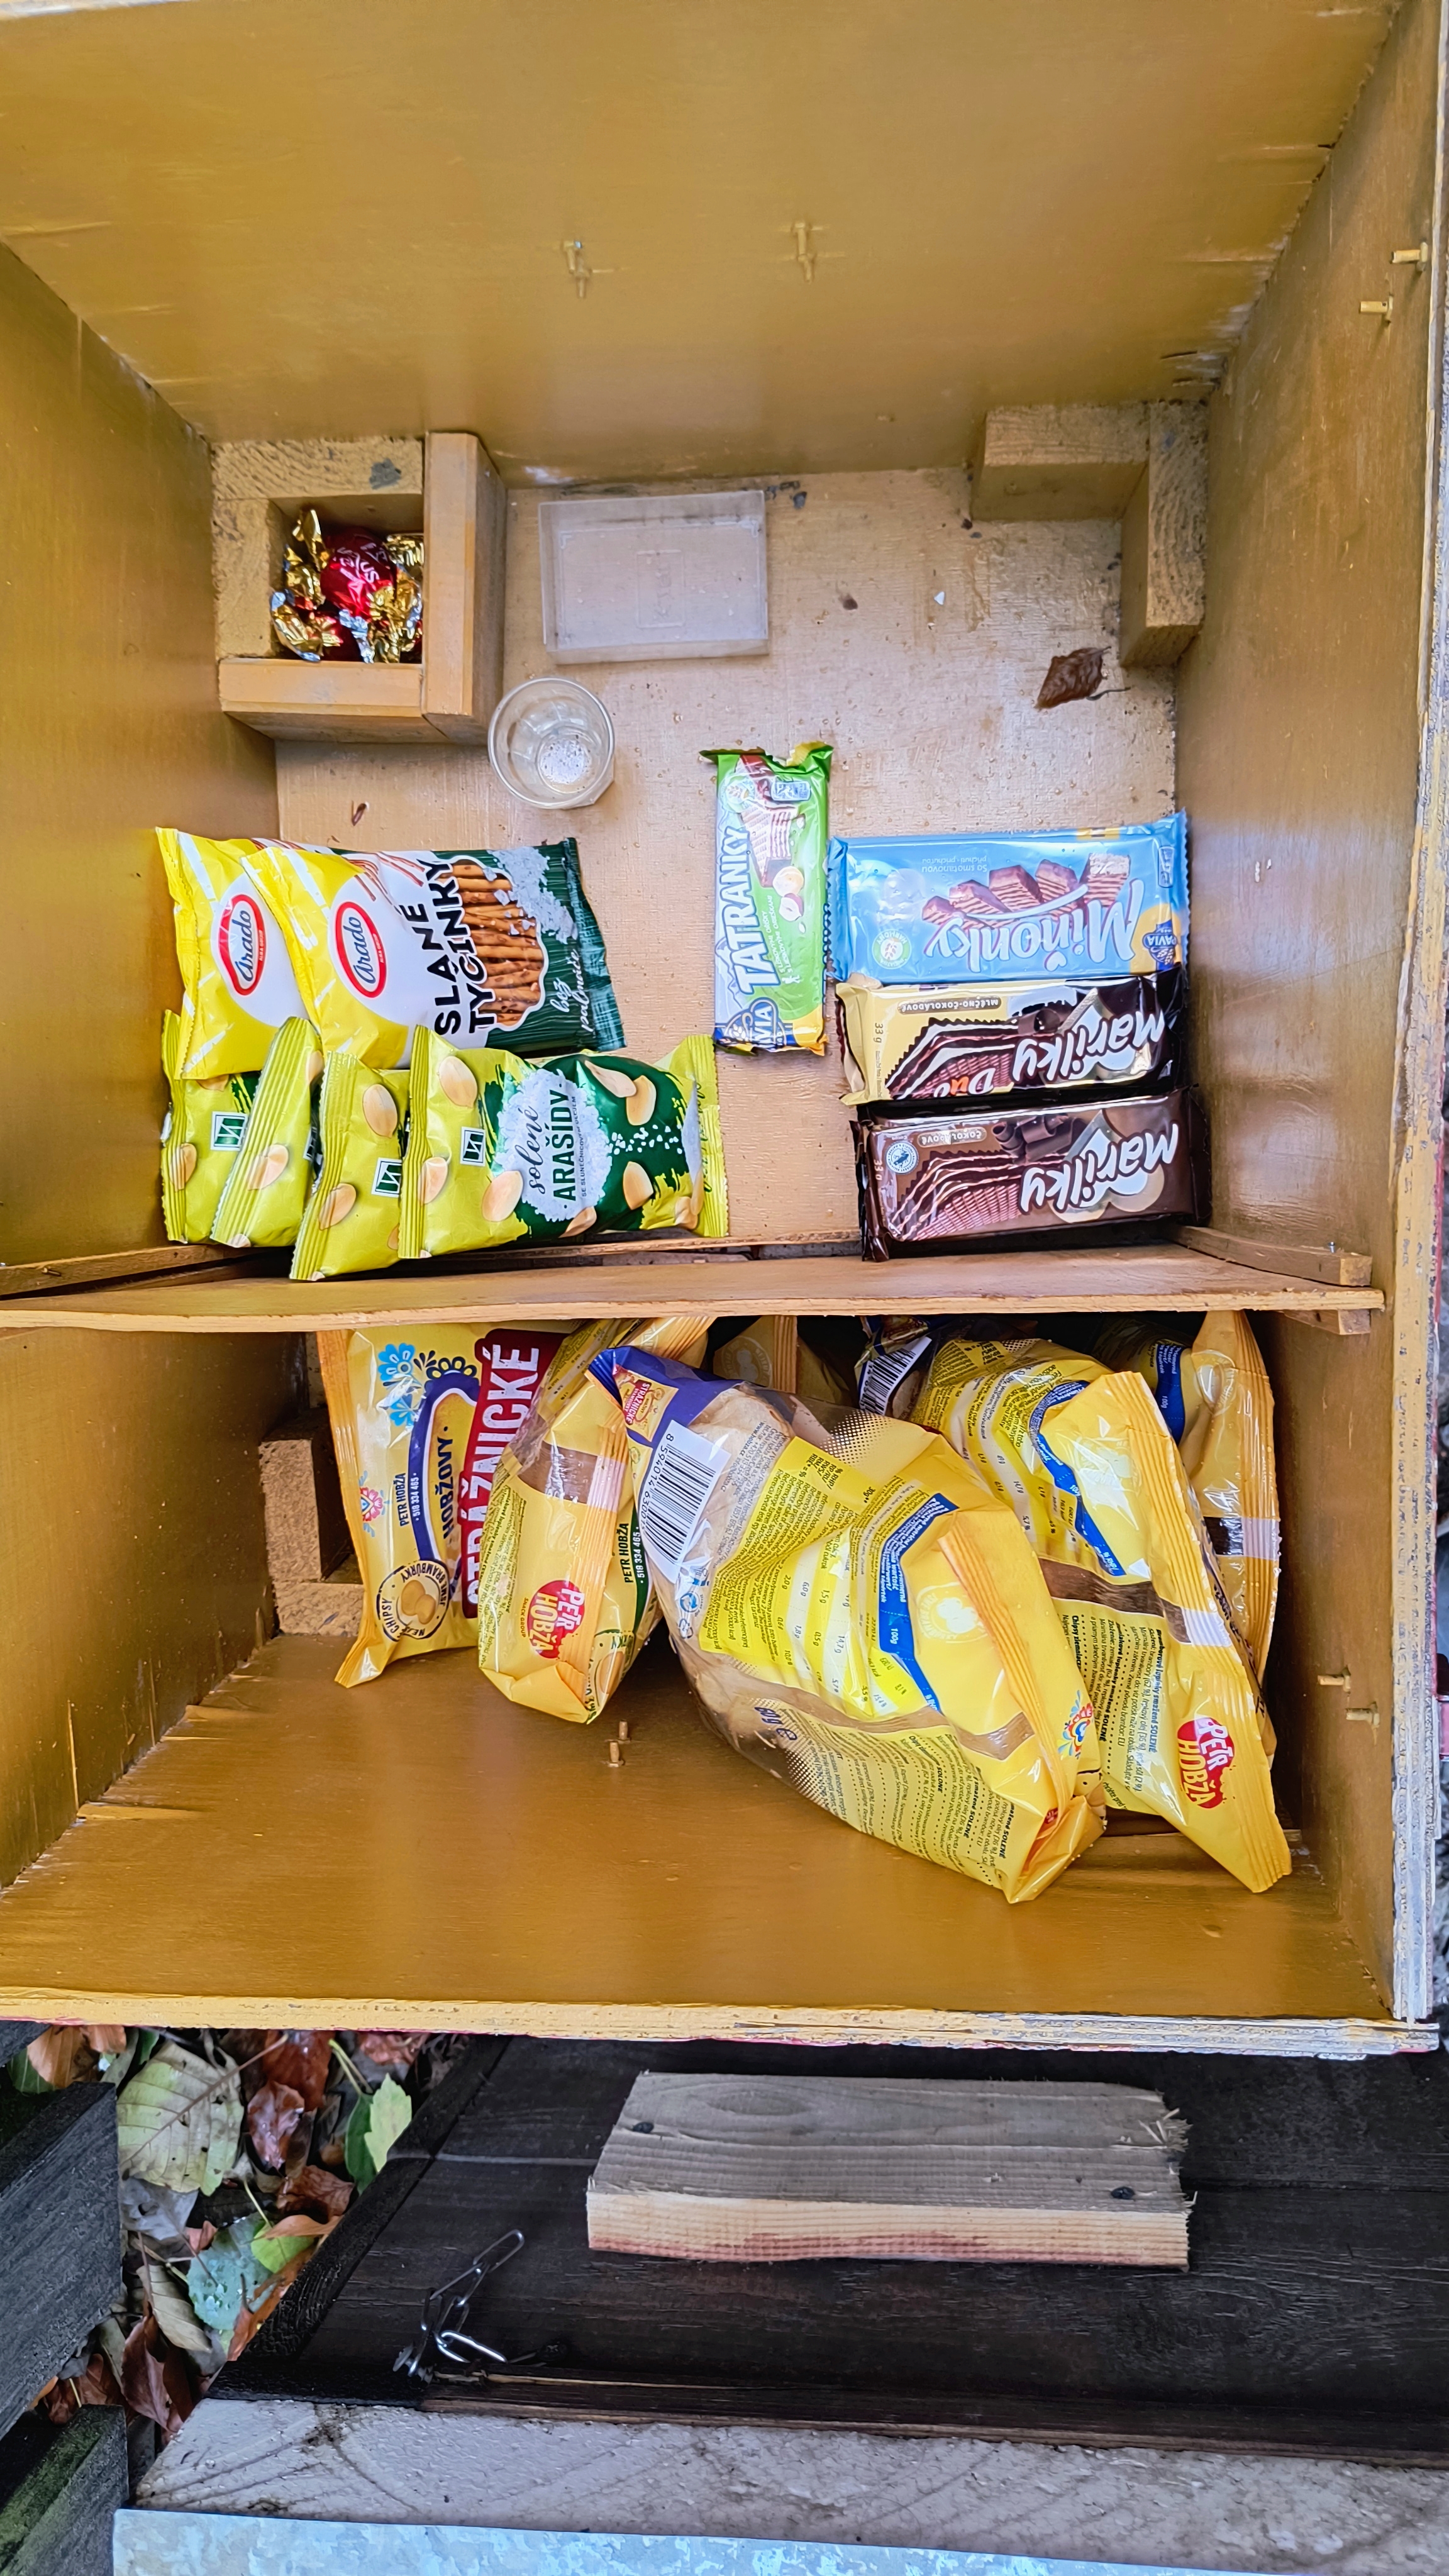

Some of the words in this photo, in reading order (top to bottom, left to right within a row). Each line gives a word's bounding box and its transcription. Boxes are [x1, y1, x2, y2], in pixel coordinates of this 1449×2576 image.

[720, 826, 781, 995] TATRANKY
[231, 910, 253, 982] Arado
[343, 916, 376, 984] Arado
[416, 859, 495, 1033] TYČINKY
[1146, 935, 1176, 945] PAVIA
[394, 903, 462, 1035] SLANÉ
[550, 977, 572, 1013] bez
[901, 996, 999, 1013] MLÉČNO-ČOKOLÁDOVÉ
[875, 1023, 883, 1035] 33
[515, 1106, 545, 1194] solené
[545, 1089, 576, 1202] ARAŠÍDY
[581, 1187, 586, 1196] SE
[665, 1433, 674, 1441] 8
[738, 1420, 764, 1457] www.hobza.cz
[461, 1344, 539, 1604] ŽNICKÉ
[647, 1445, 668, 1487] 594014
[825, 1472, 839, 1489] RHP/
[393, 1473, 406, 1502] HOBŽA
[411, 1477, 419, 1489] 465
[435, 1436, 454, 1540] HOBŽOVY
[397, 1503, 409, 1526] PETR
[616, 1523, 629, 1555] HOBŽA
[633, 1532, 641, 1546] 465
[634, 1548, 643, 1564] 334
[619, 1558, 634, 1584] PETR
[636, 1566, 645, 1579] 518
[381, 1598, 400, 1634] CHIPSY
[521, 1597, 529, 1618] SNACK
[530, 1592, 558, 1652] HOBŽA
[557, 1588, 585, 1631] PETR
[1070, 1614, 1079, 1635] Chipsy
[1145, 1650, 1155, 1677] brambory
[1129, 1697, 1139, 1716] potisk
[1133, 1689, 1141, 1697] viz
[754, 1705, 783, 1726] 60g
[1098, 1713, 1111, 1742] SOLENÉ
[1117, 1736, 1125, 1747] EU
[1148, 1724, 1158, 1753] SOLENÉ
[1198, 1724, 1234, 1771] PETR
[1178, 1740, 1216, 1806] HOBŽA
[963, 1810, 974, 1838] SOLENÉ
[976, 1835, 984, 1847] EU
[1000, 1829, 1009, 1860] SOLENÉ
